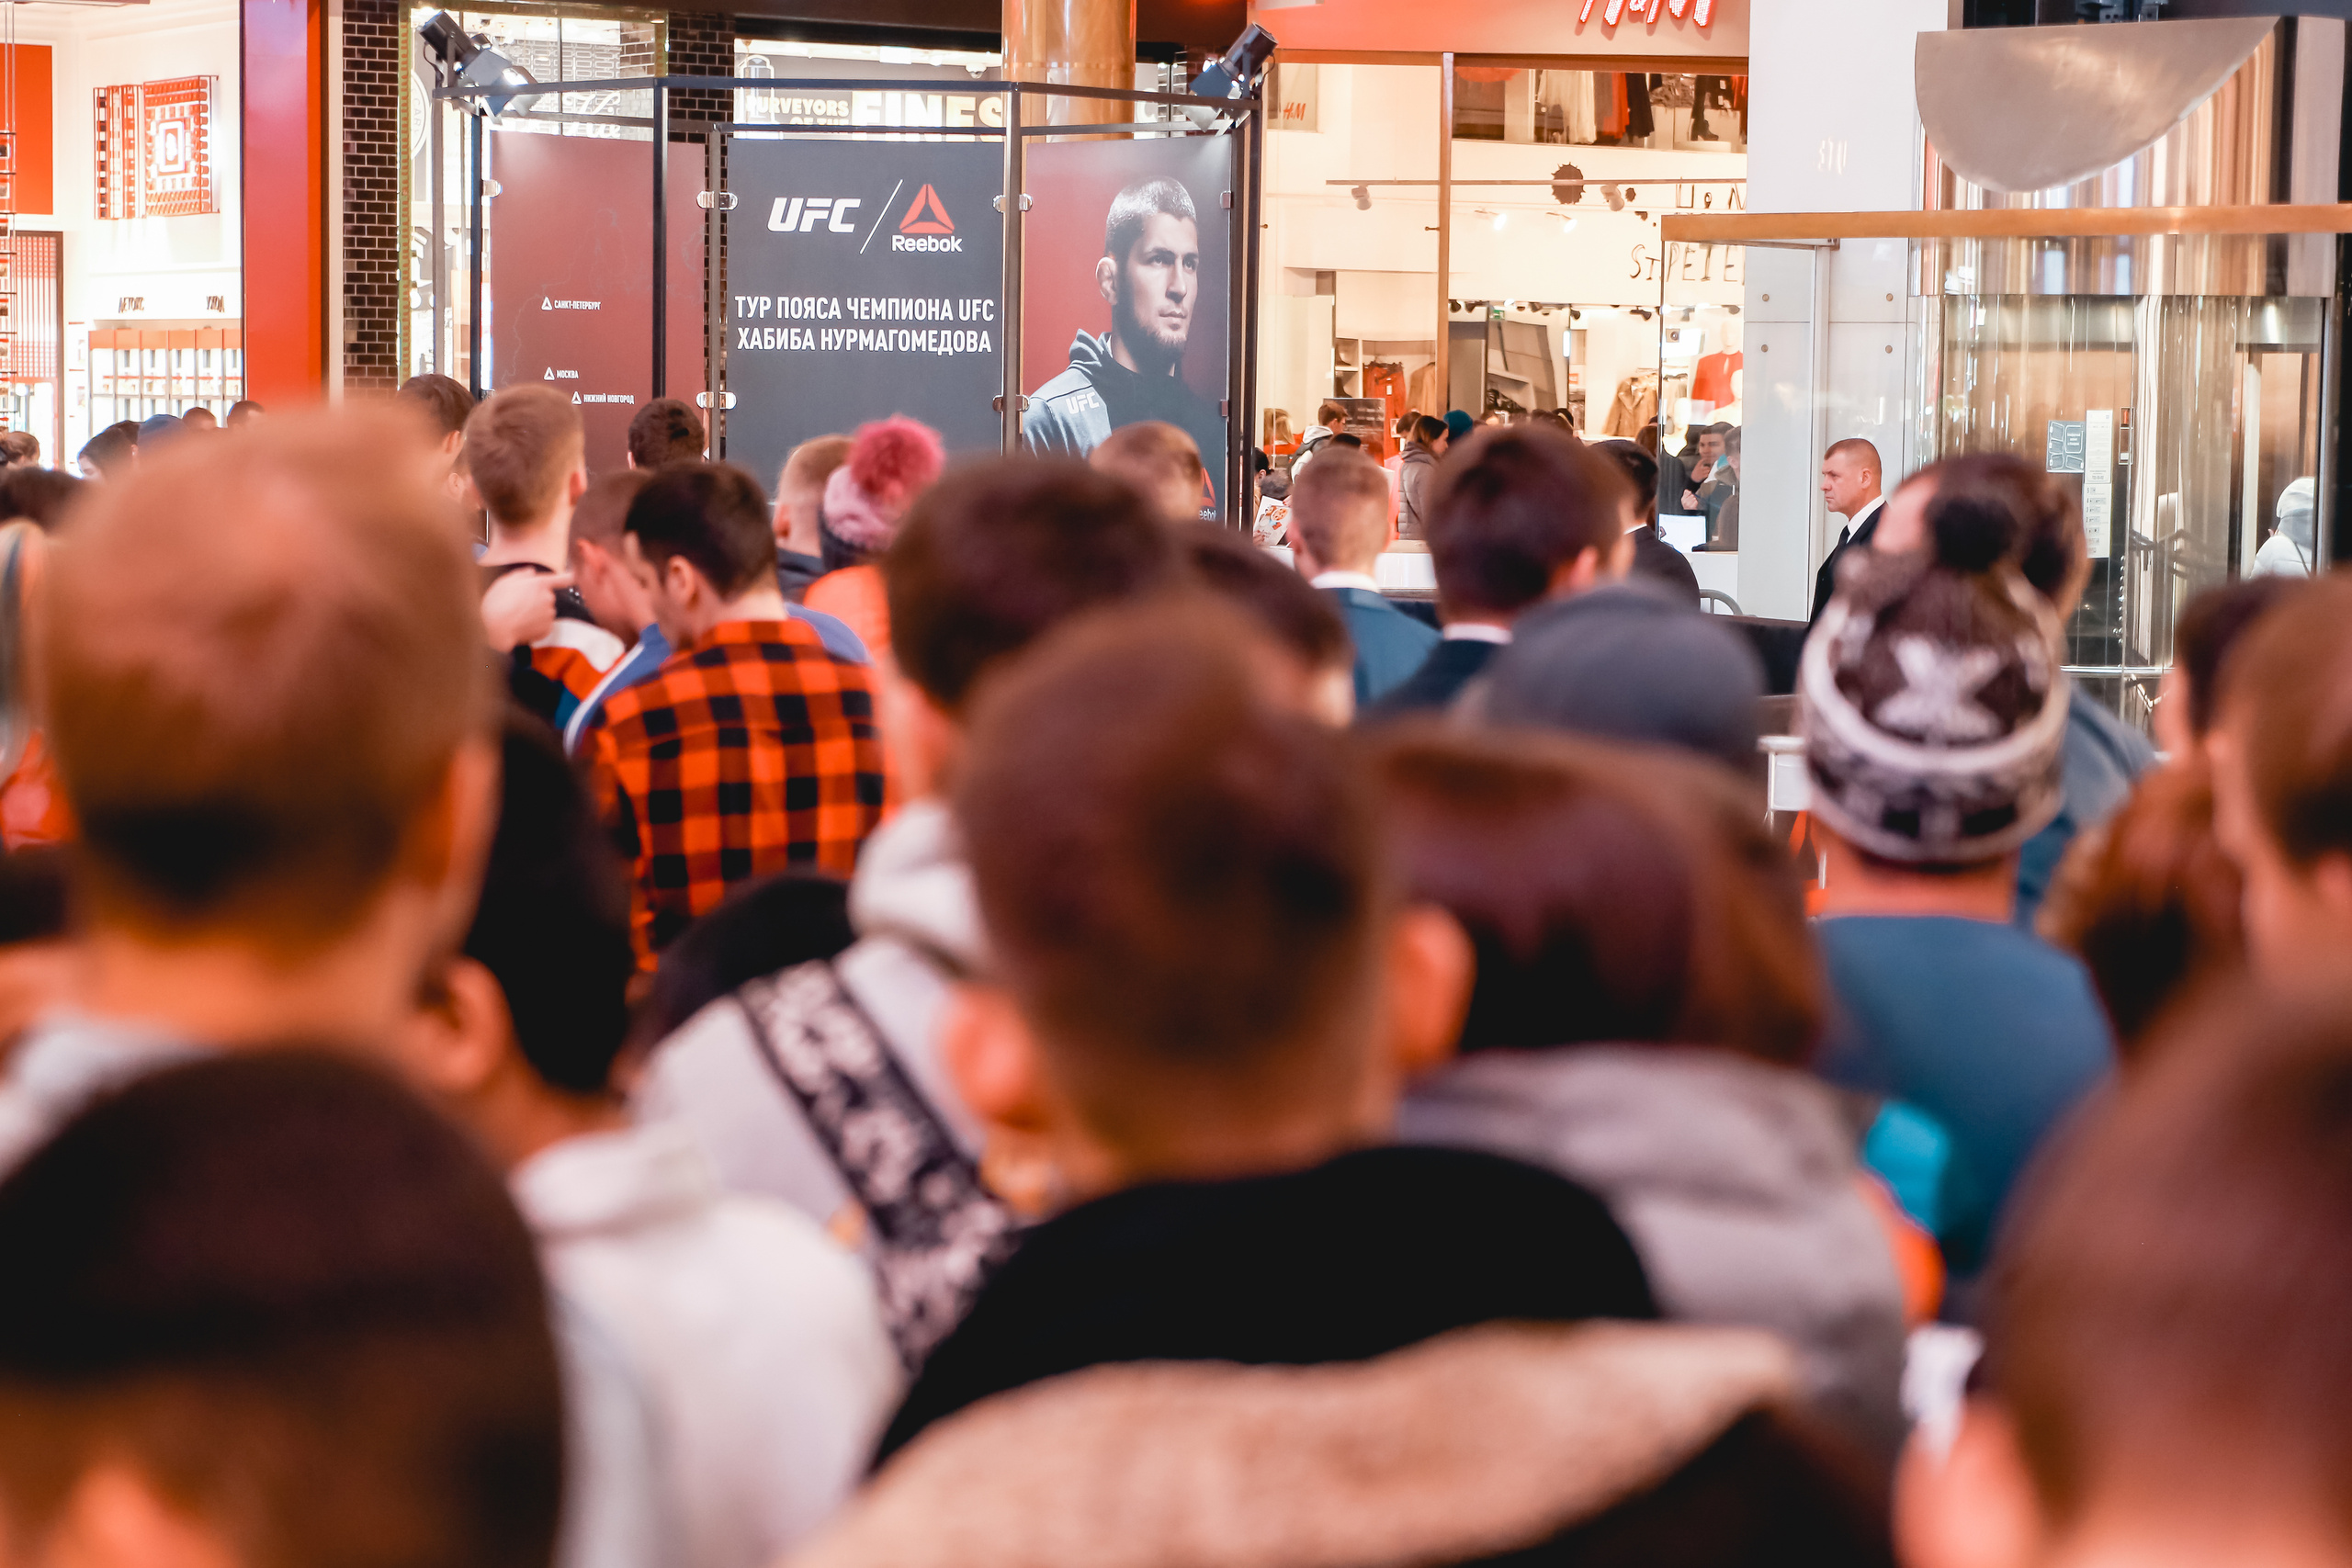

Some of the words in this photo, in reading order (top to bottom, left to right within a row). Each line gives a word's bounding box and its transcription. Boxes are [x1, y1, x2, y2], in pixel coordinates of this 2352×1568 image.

[767, 197, 862, 232] UFC
[892, 234, 963, 253] Reebok
[554, 299, 602, 310] САНКТ-ПЕТЕРБУРГ
[735, 296, 772, 319] ТУР
[777, 296, 842, 320] ПОЯСА
[846, 298, 954, 321] ЧЕМПИОНА
[958, 299, 995, 321] UFC
[737, 327, 816, 351] ХАБИБА
[820, 328, 992, 355] НУРМАГОМЕДОВА
[557, 370, 579, 379] МОСКВА
[583, 393, 606, 403] НИЖНИЙ
[607, 394, 635, 405] НОВГОРОД
[1066, 392, 1100, 414] UFC
